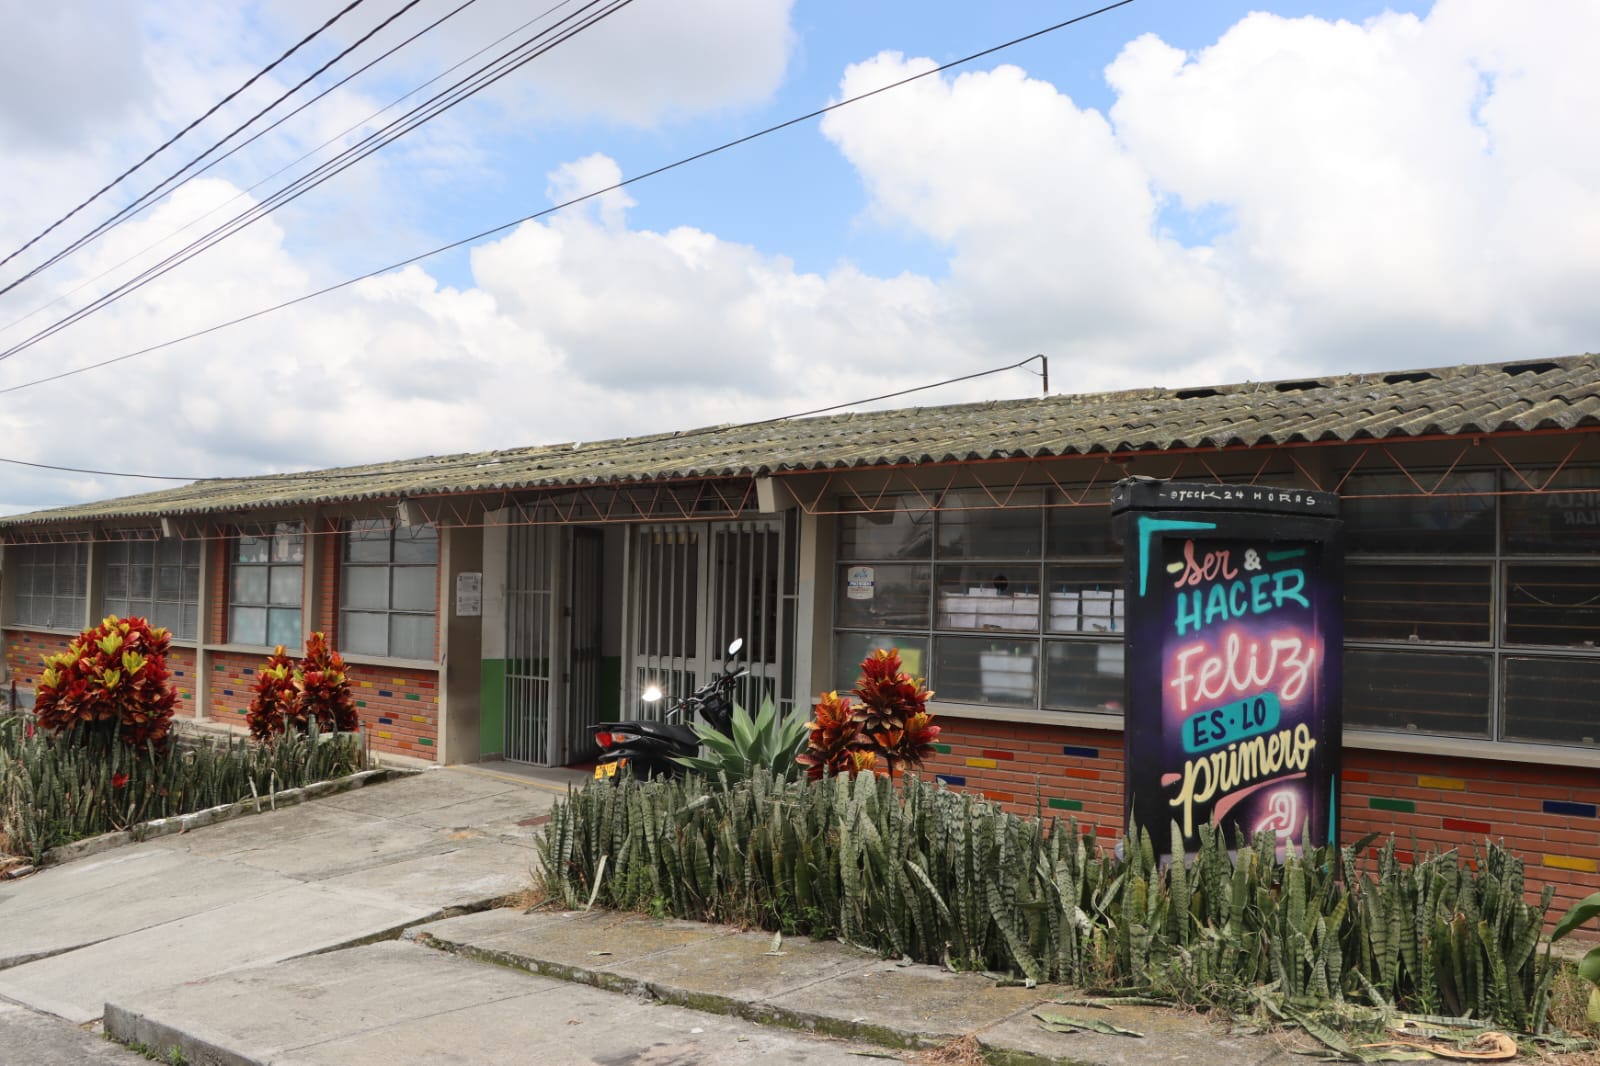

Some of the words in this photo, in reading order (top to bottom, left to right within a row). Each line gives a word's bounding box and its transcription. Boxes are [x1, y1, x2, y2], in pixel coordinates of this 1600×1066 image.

[1223, 489, 1244, 500] 24
[1253, 491, 1316, 506] HORAS
[1243, 549, 1262, 571] &
[1174, 568, 1310, 636] HACER
[1170, 632, 1316, 711] Feliz
[1168, 722, 1317, 838] primero
